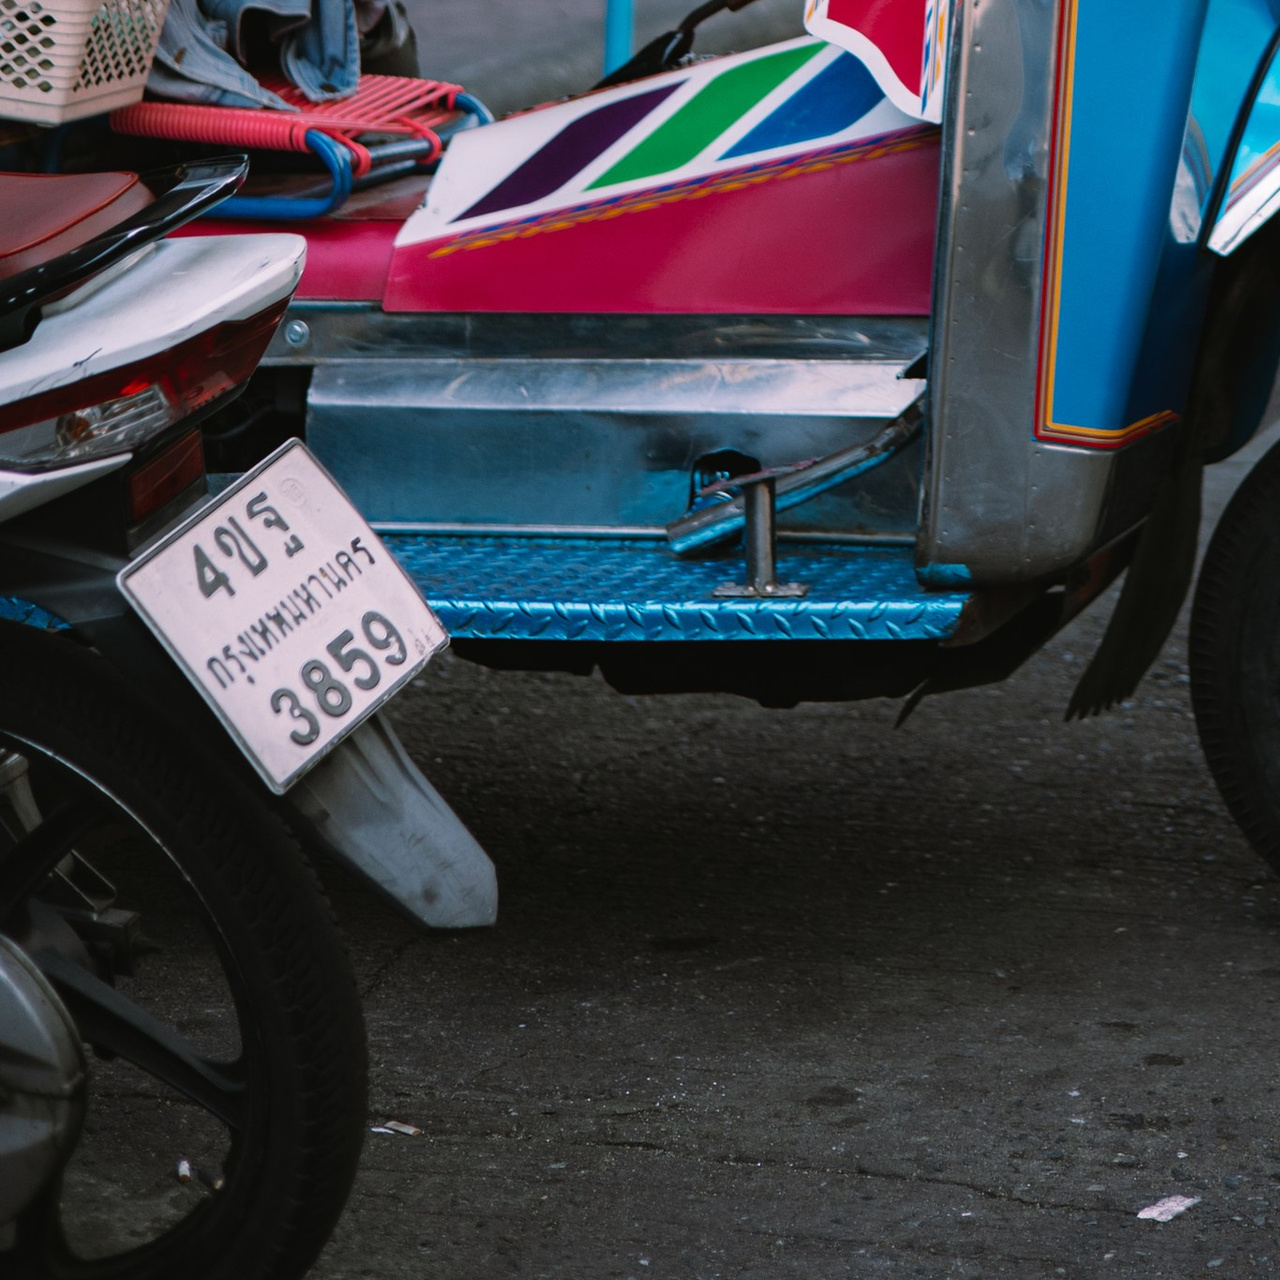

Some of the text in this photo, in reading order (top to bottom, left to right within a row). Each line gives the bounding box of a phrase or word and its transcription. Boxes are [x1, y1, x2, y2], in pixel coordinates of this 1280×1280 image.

[193, 492, 305, 600] 4ขฐ
[206, 537, 376, 689] กรุงเทพมหานคร
[270, 610, 408, 747] 3859
